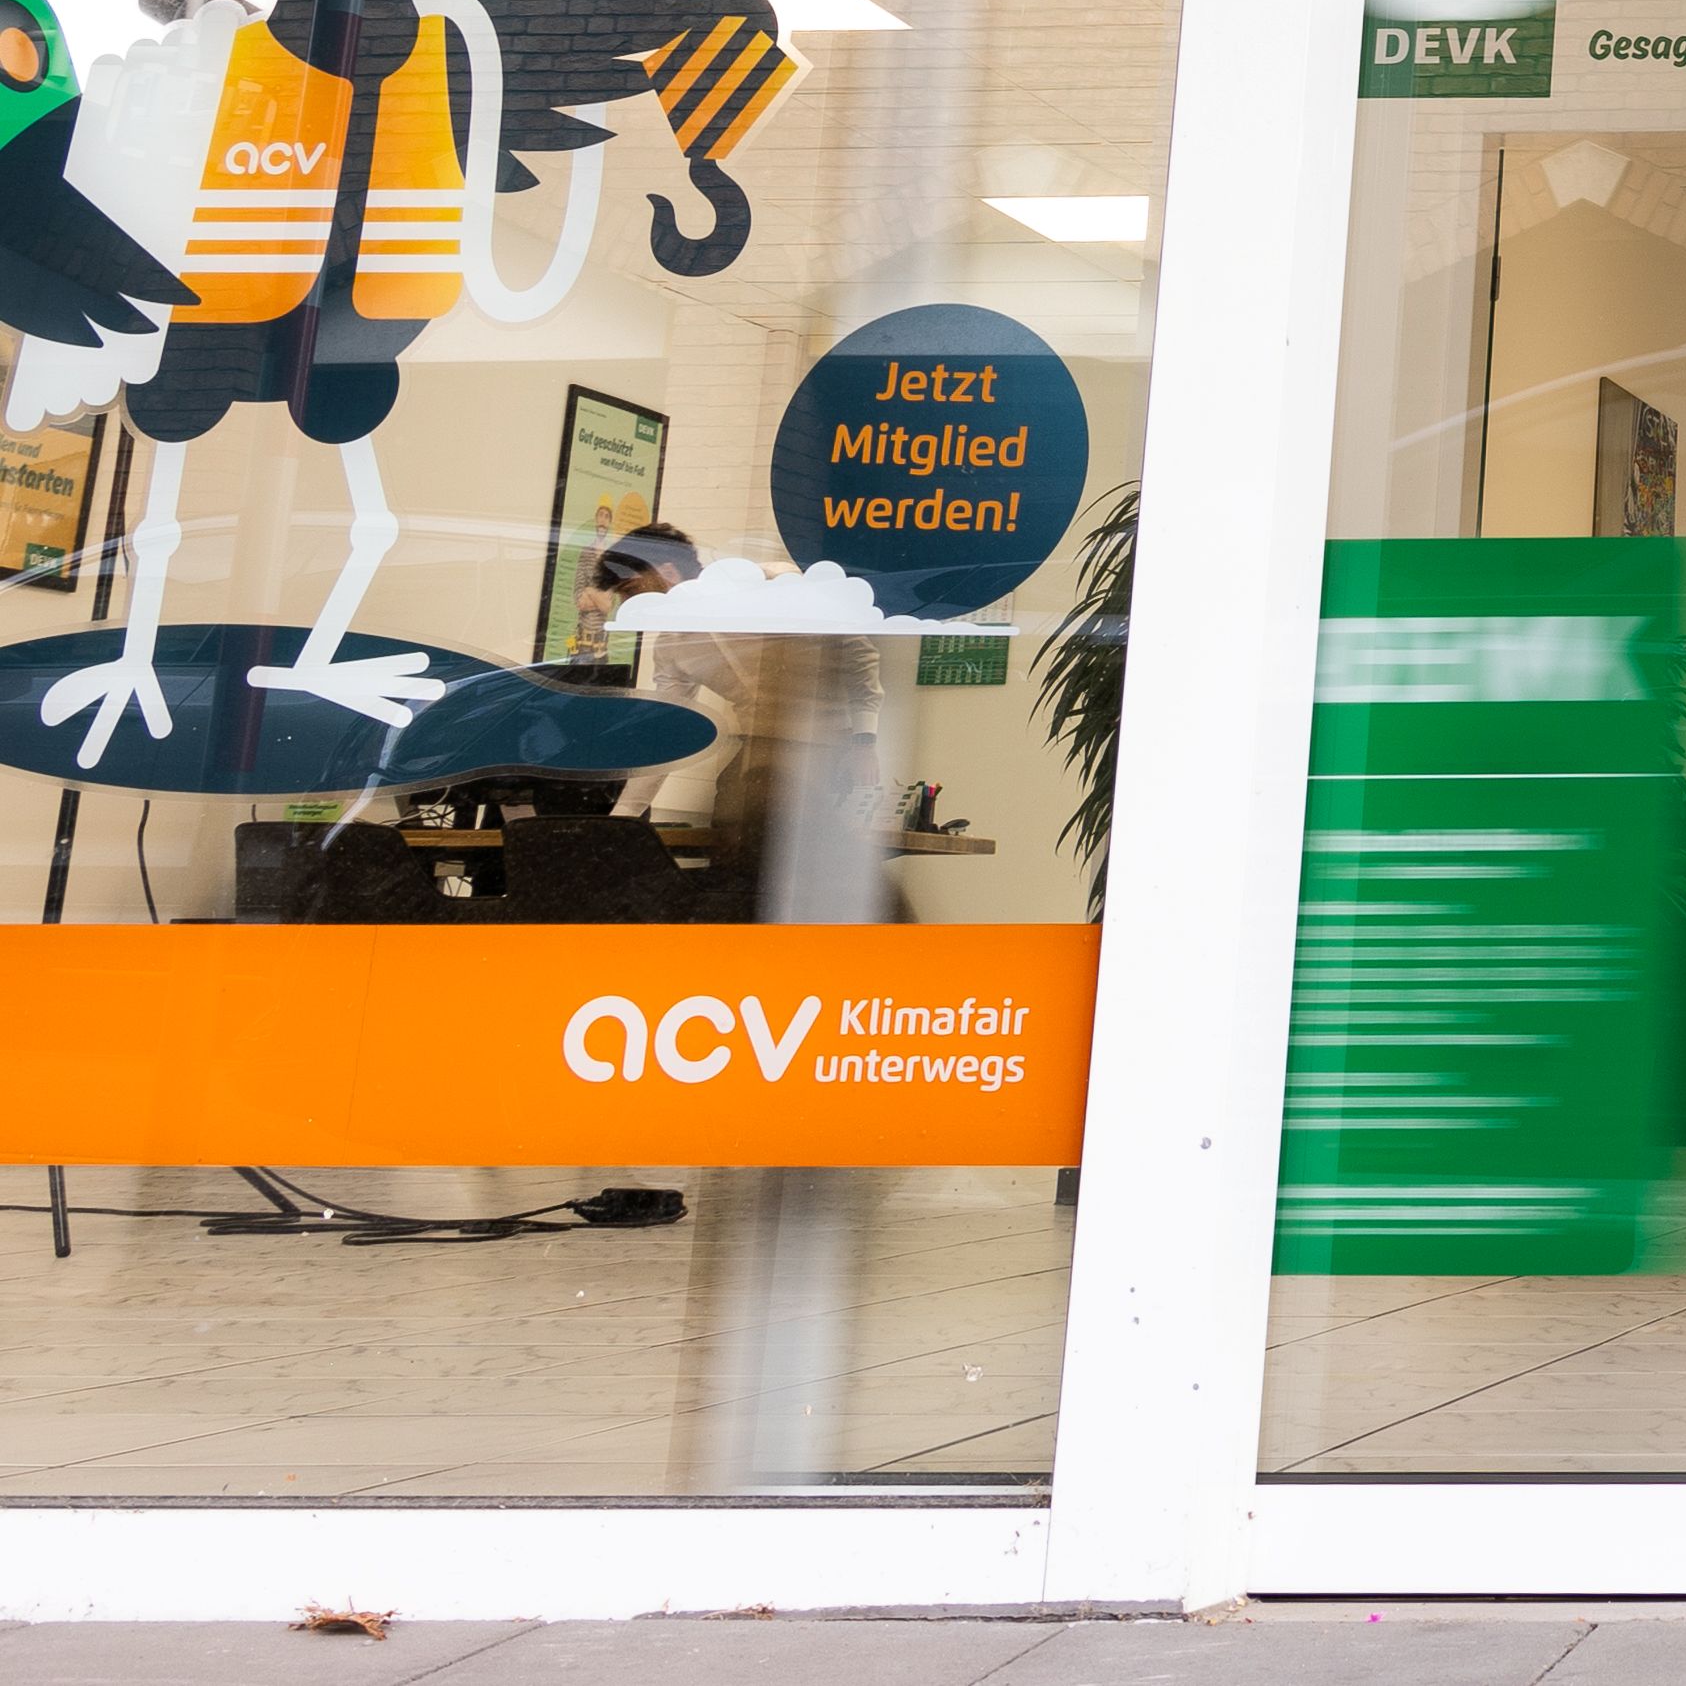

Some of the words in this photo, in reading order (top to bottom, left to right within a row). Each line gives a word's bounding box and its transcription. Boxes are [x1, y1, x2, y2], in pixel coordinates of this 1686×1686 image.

[1372, 26, 1519, 66] DEVK
[225, 140, 328, 177] acv
[874, 360, 998, 404] Jetzt
[831, 423, 1029, 476] Mitglied
[823, 488, 1020, 533] werden!
[562, 995, 822, 1085] acv
[839, 998, 1030, 1038] Klimafair
[813, 1049, 1025, 1091] unterwegs
